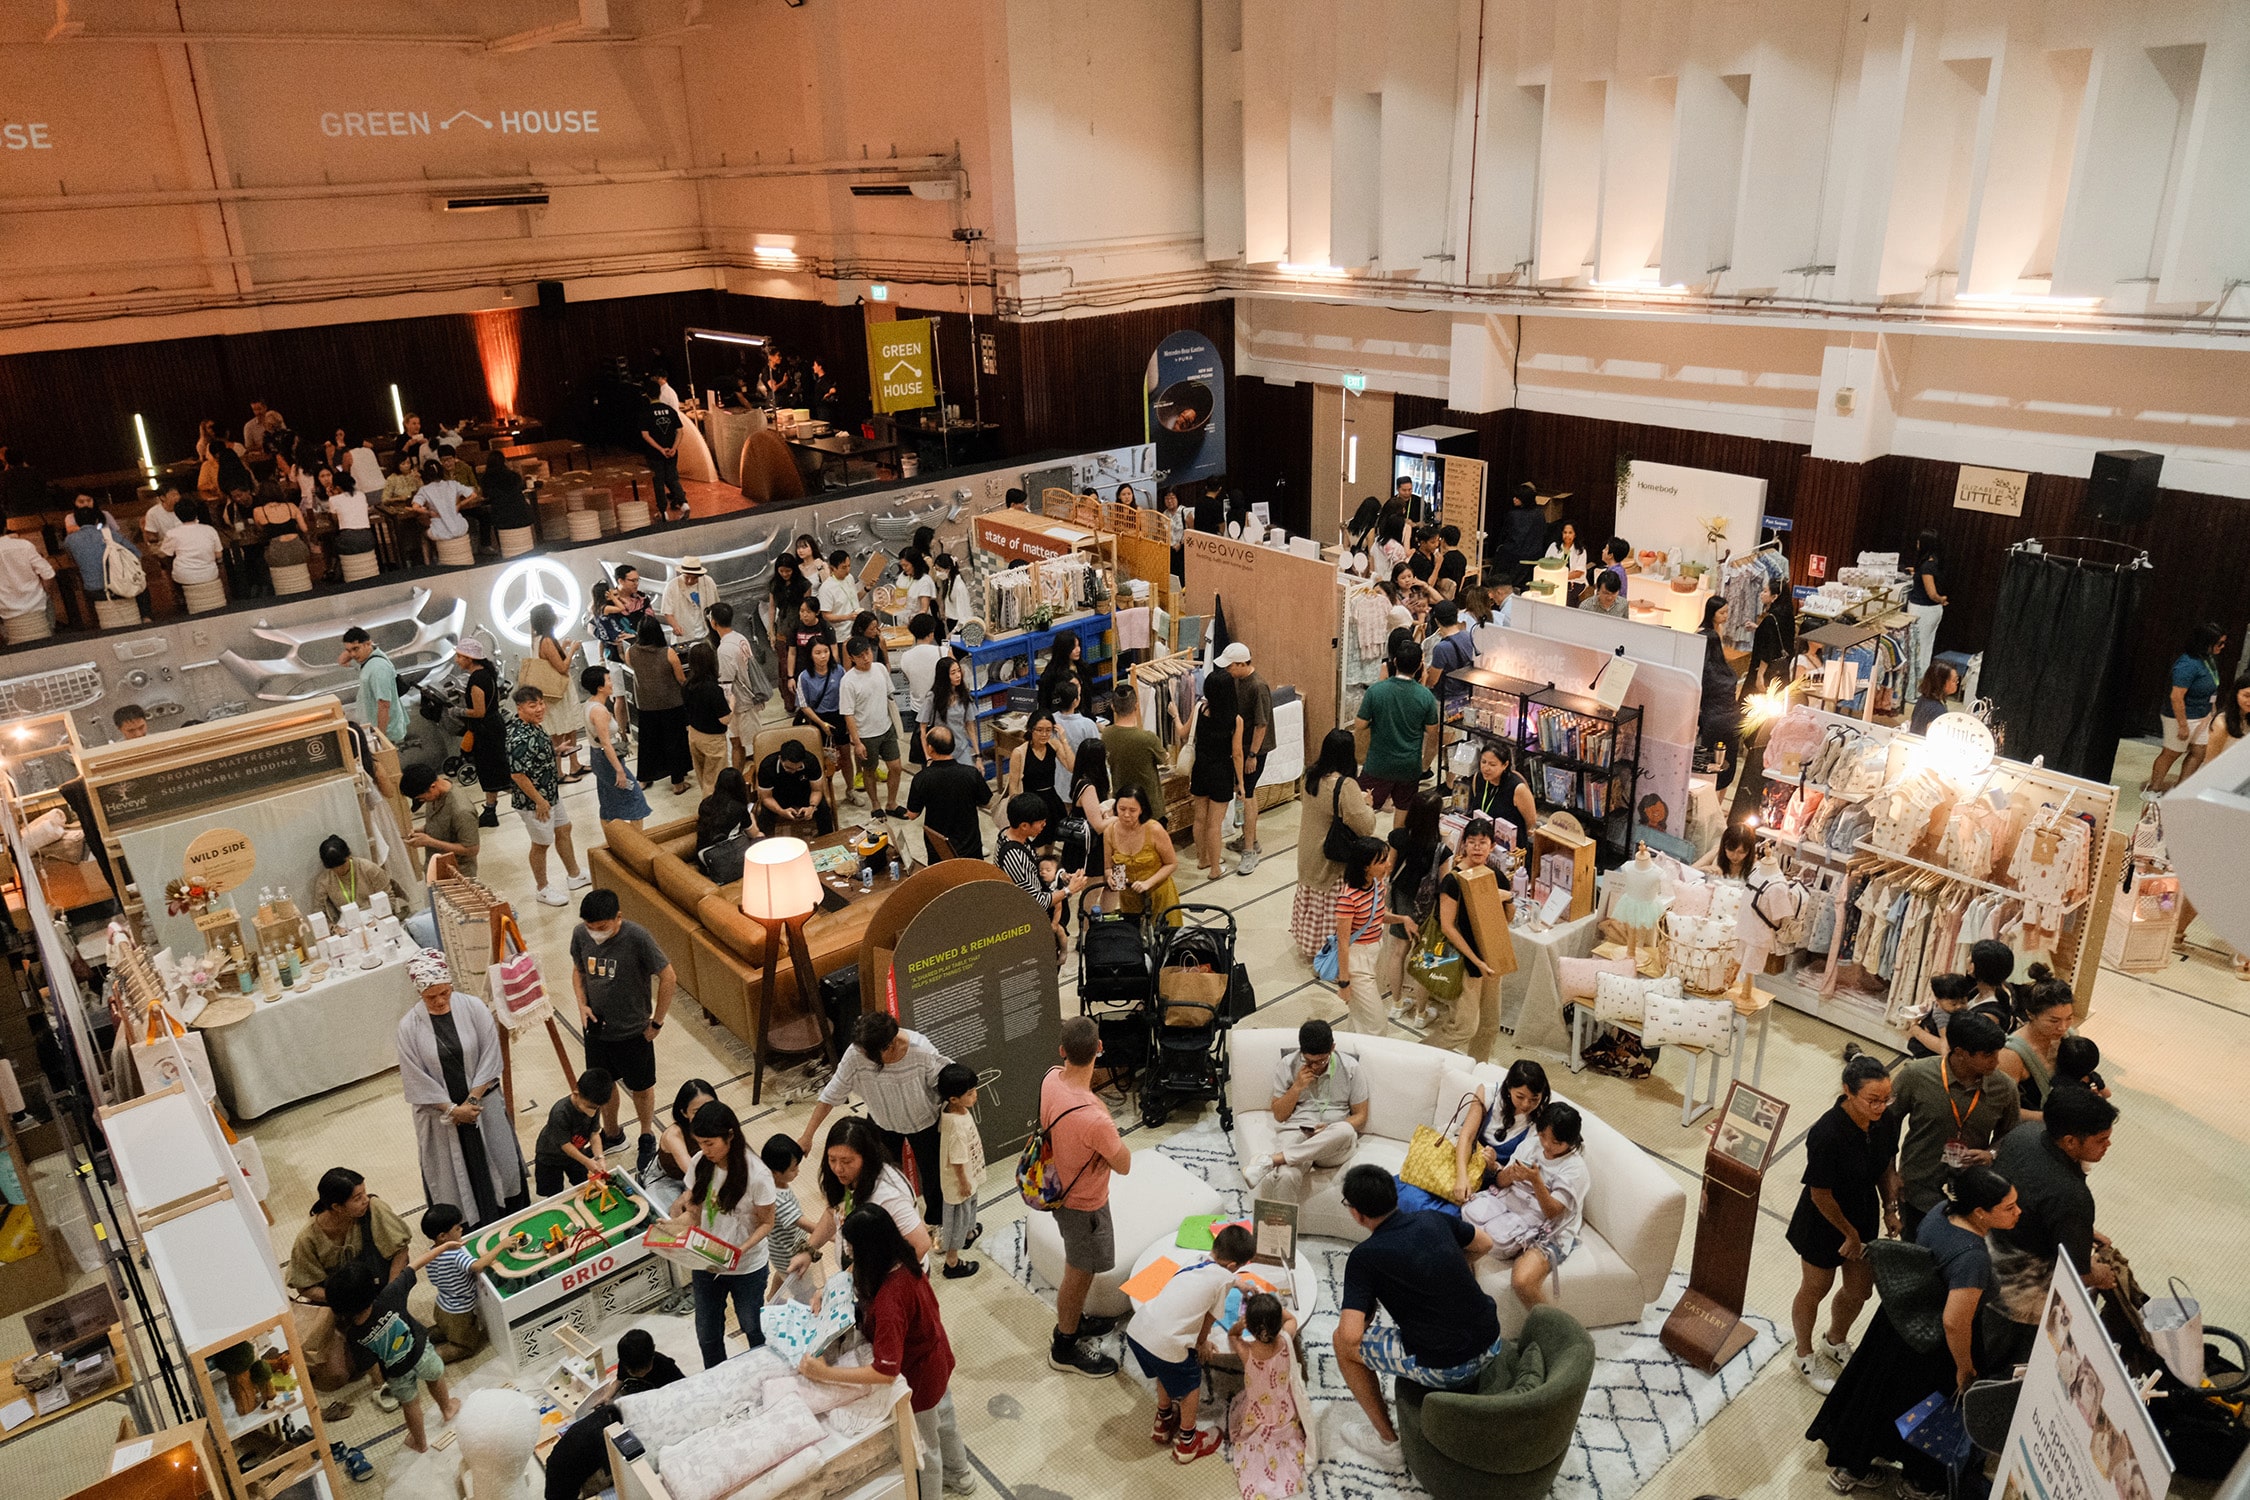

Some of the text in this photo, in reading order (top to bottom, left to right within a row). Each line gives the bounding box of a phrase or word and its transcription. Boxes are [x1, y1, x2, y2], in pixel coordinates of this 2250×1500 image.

[320, 110, 600, 137] GREEN HOUSE
[882, 342, 921, 358] GREEN
[883, 382, 923, 398] HOUSE
[1637, 481, 1678, 496] Homebody
[1960, 490, 2003, 506] LITTLE
[1961, 484, 2005, 495] ELIZABETH
[985, 530, 1060, 560] state of matters
[1195, 539, 1254, 563] weavve
[157, 745, 295, 783] ORGANIC MATTRESSES
[161, 757, 298, 796] SUSTAINABLE BEDDING
[190, 841, 246, 864] WILD SIDE
[908, 923, 1032, 974] RENEWED & REIMAGINED
[912, 979, 928, 990] HELPS
[929, 974, 942, 983] KEEP
[943, 967, 962, 977] THINGS
[917, 969, 938, 980] SHARED
[938, 964, 951, 974] PLAY
[952, 959, 967, 968] TABLE
[968, 953, 981, 962] THAT
[561, 1255, 615, 1291] BRIO
[378, 1310, 393, 1325] Pro
[1683, 1301, 1728, 1329] CASTLERY
[2032, 1407, 2066, 1482] bunnies
[2033, 1442, 2053, 1484] care
